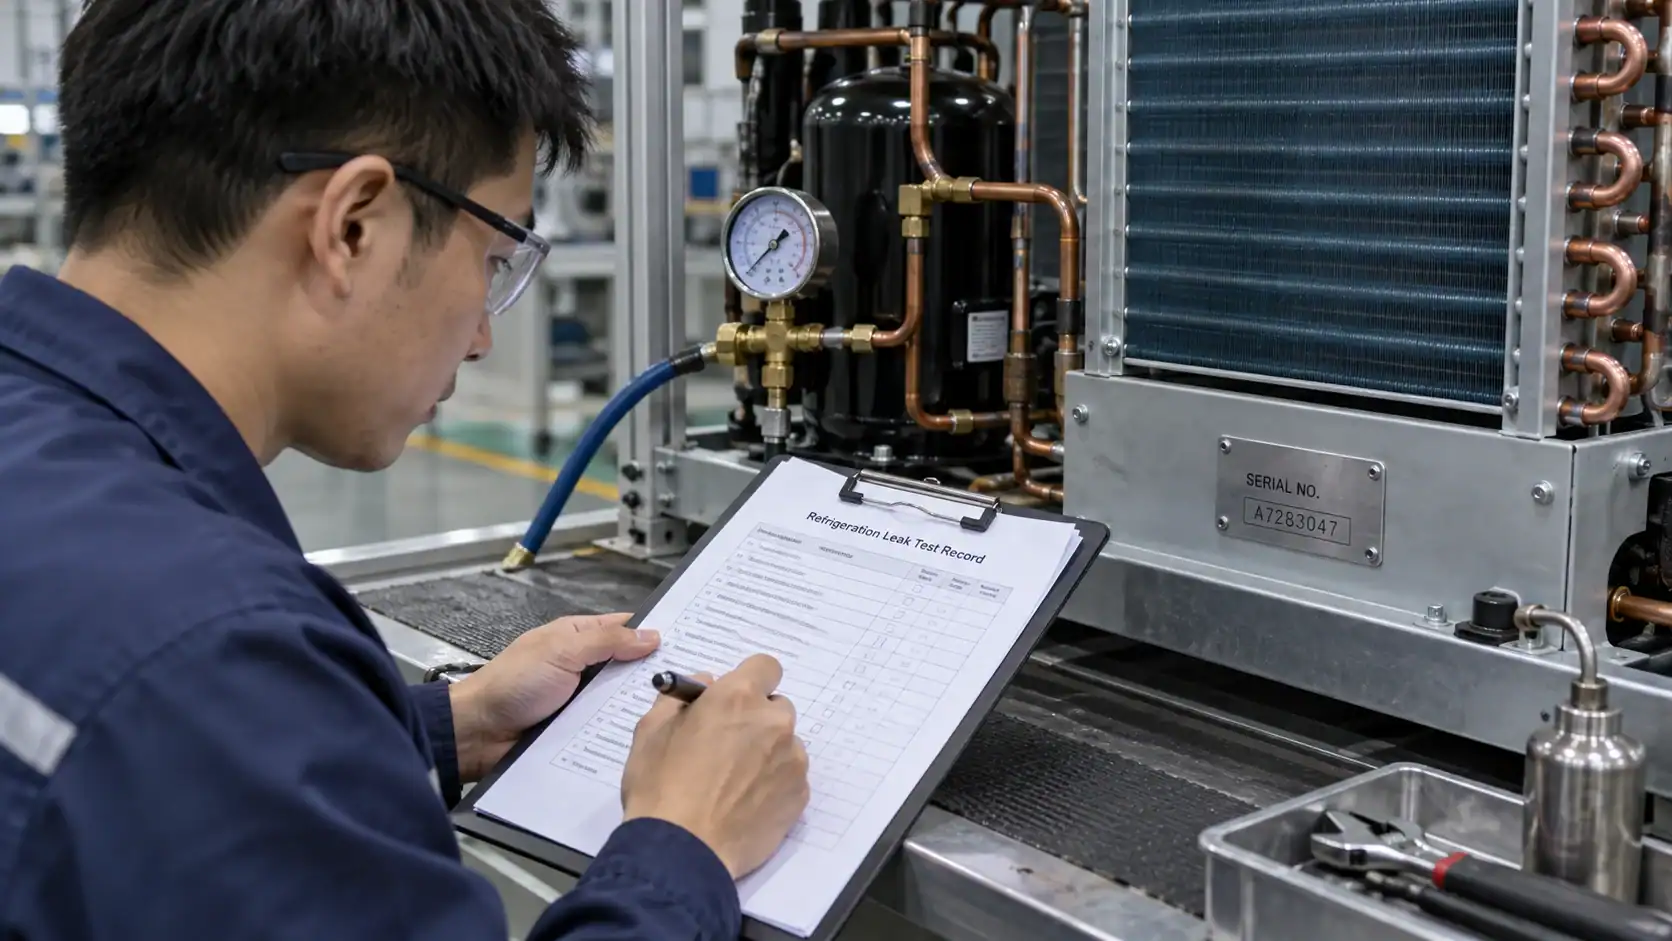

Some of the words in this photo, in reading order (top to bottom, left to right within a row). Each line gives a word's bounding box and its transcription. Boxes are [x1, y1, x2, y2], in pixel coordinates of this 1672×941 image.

[1246, 473, 1292, 494] SERIAL
[1296, 482, 1320, 499] NO.
[1254, 505, 1338, 536] A7283047
[806, 511, 880, 538] Refrigeration
[883, 531, 912, 546] Leak
[914, 539, 940, 553] Test
[940, 545, 986, 564] Record
